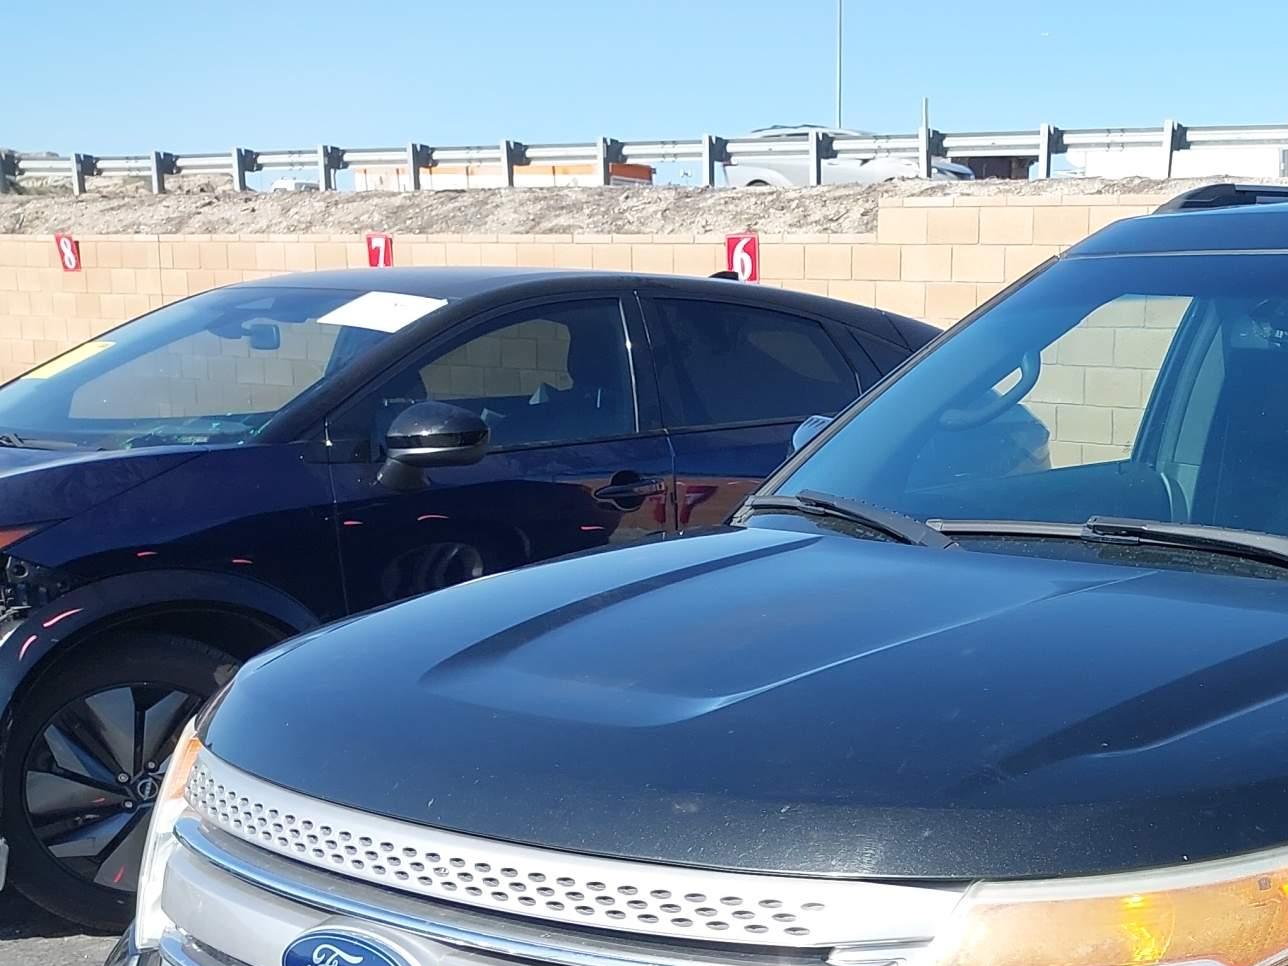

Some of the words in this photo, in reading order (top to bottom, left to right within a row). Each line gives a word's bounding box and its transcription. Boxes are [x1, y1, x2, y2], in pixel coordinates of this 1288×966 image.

[60, 237, 76, 269] 8
[371, 237, 386, 268] 7
[732, 237, 753, 282] 6
